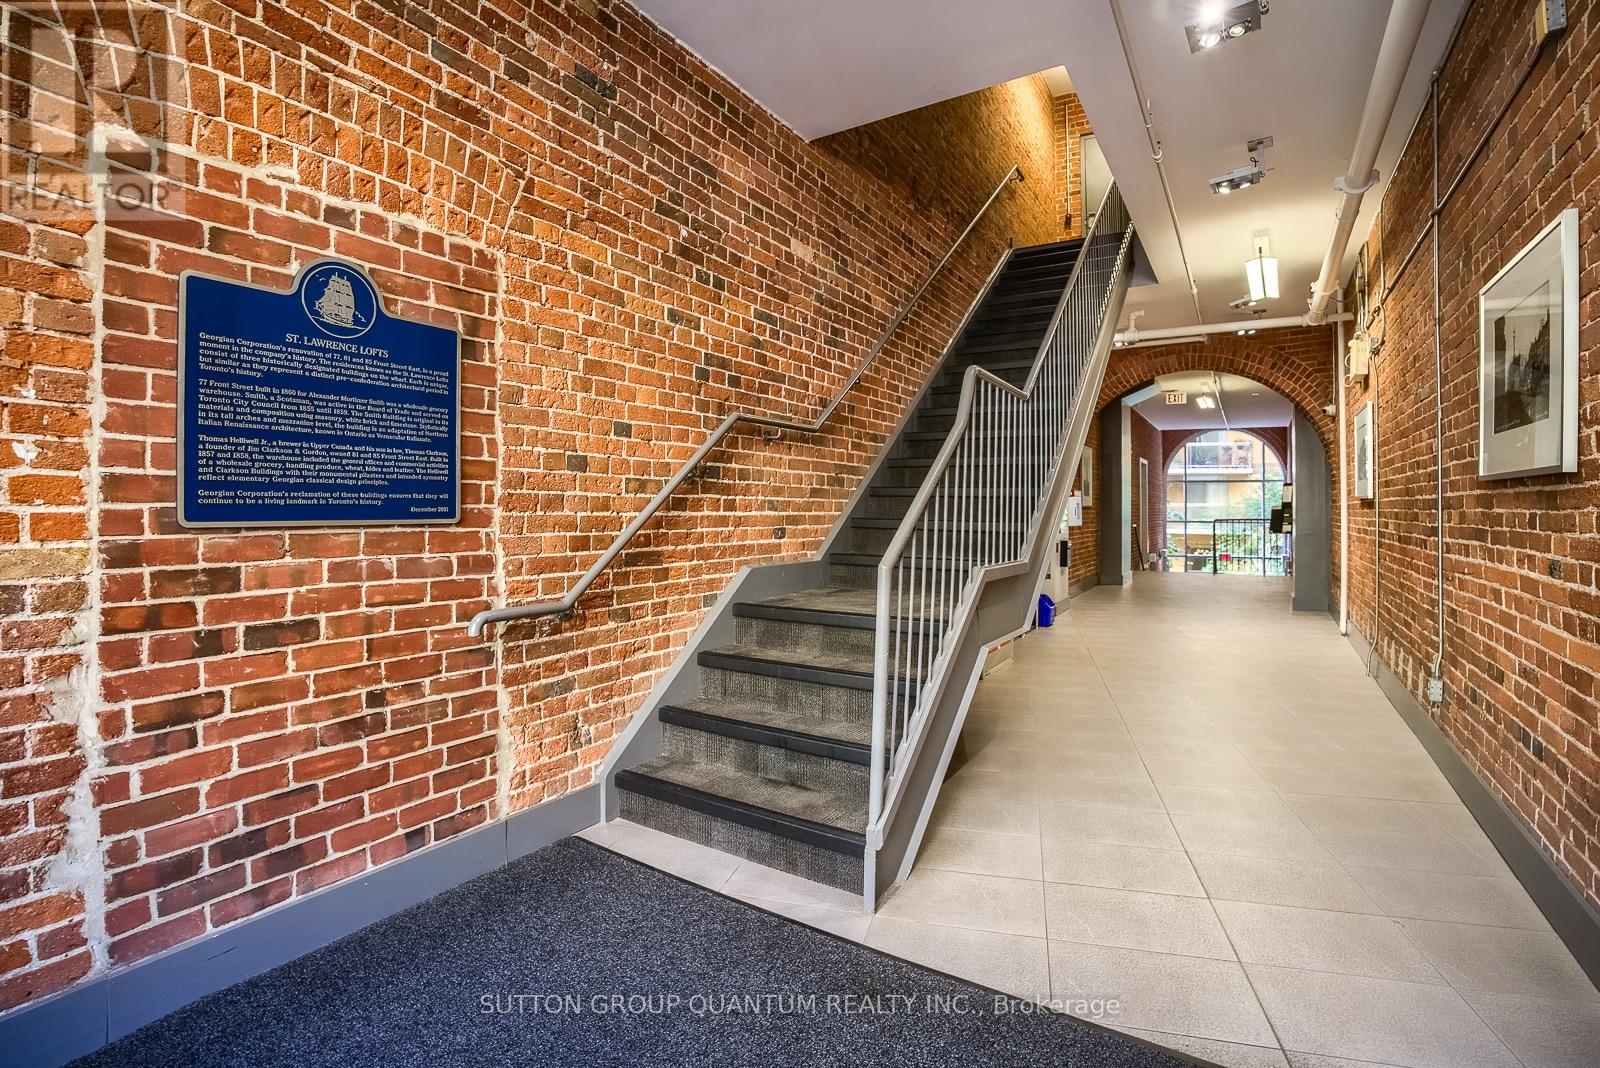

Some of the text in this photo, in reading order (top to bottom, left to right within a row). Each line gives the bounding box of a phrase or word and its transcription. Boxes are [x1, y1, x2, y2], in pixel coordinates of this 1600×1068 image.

[200, 332, 235, 345] Georgian
[237, 338, 286, 353] Corporation's
[288, 346, 323, 357] renovation
[200, 340, 230, 351] moment
[255, 349, 291, 361] company's
[286, 334, 389, 358] ST. LAWRENCE LOFTS
[199, 348, 228, 358] consist
[241, 354, 261, 362] three
[263, 357, 302, 370] historically
[305, 363, 340, 375] designated
[199, 363, 234, 373] Toronto's
[215, 358, 239, 367] similar
[253, 363, 268, 372] they
[270, 365, 303, 376] represent
[311, 371, 335, 379] distinct
[210, 380, 229, 388] Front
[232, 383, 253, 391] Street
[309, 392, 339, 400] Alexander
[199, 395, 231, 404] Toronto
[233, 399, 248, 407] City
[251, 400, 279, 408] Council
[1168, 393, 1184, 403] EXIT
[198, 403, 234, 412] materials
[252, 408, 295, 419] composition
[296, 412, 314, 420] using
[224, 421, 269, 430] Renaissance
[236, 414, 261, 422] arches
[278, 418, 313, 426] mezzanine
[198, 435, 228, 443] Thomas
[311, 442, 329, 450] Upper
[262, 446, 292, 454] Clarkson
[216, 459, 252, 467] wholesale
[251, 468, 283, 476] Buildings
[227, 475, 269, 483] elementary
[198, 489, 235, 497] Georgian
[237, 490, 288, 498] Corporation's
